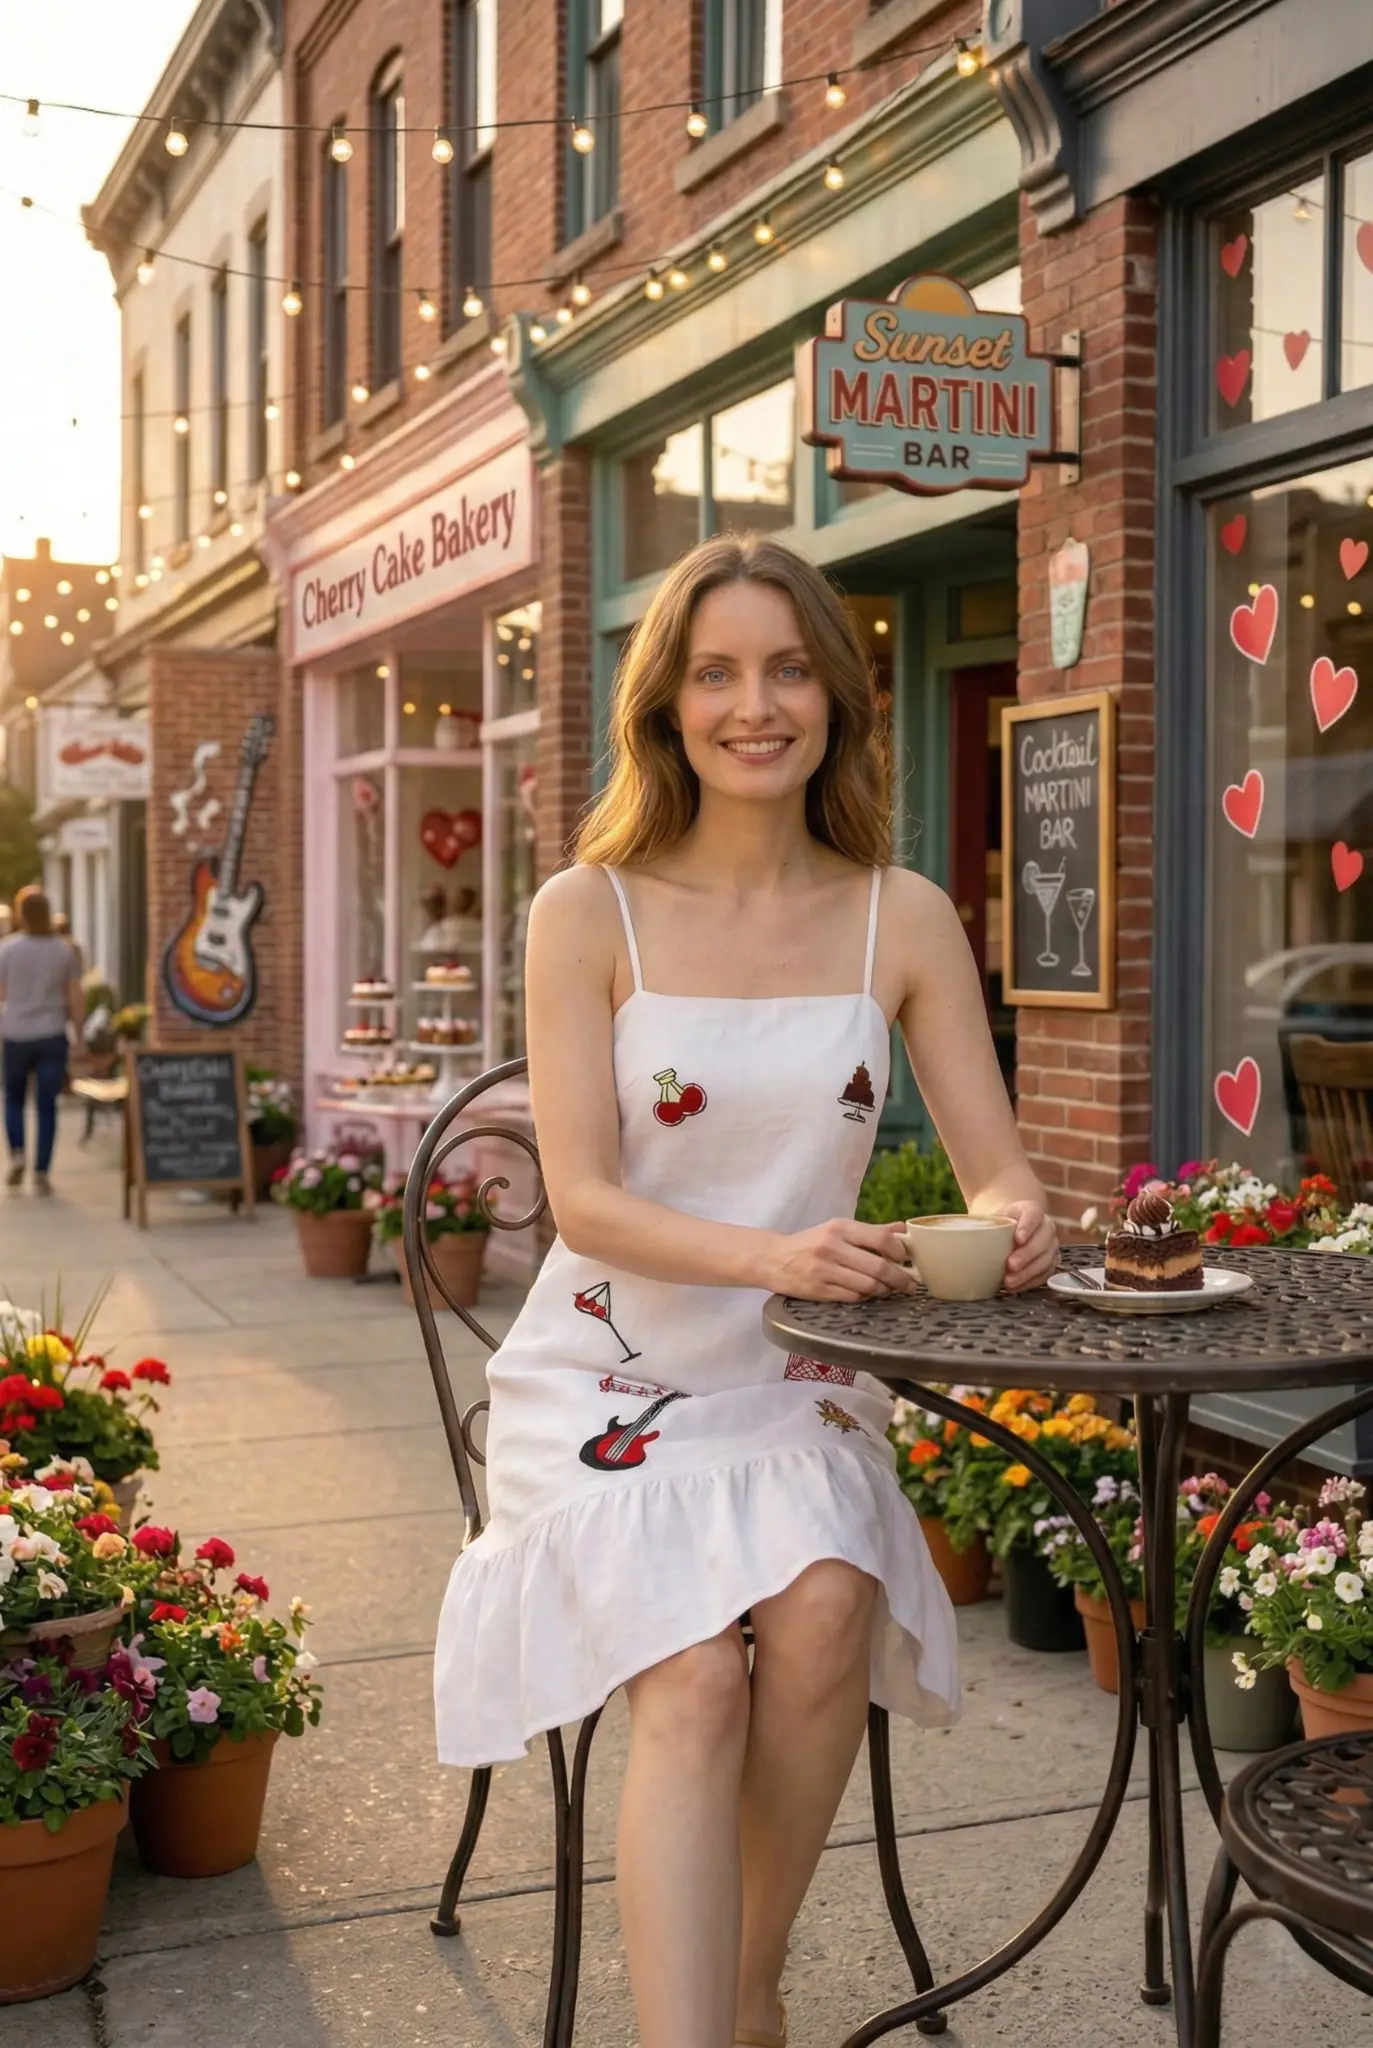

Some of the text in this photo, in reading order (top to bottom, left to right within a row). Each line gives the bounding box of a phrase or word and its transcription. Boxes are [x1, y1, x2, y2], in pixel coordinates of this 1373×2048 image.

[853, 309, 1013, 371] Sunset
[830, 367, 1039, 439] MARTINI
[903, 441, 971, 470] BAR
[302, 488, 516, 629] Cherry Cake Bakery
[1019, 723, 1097, 777] Cocktail
[1024, 776, 1091, 814] MARTINI
[1039, 816, 1077, 850] BAR
